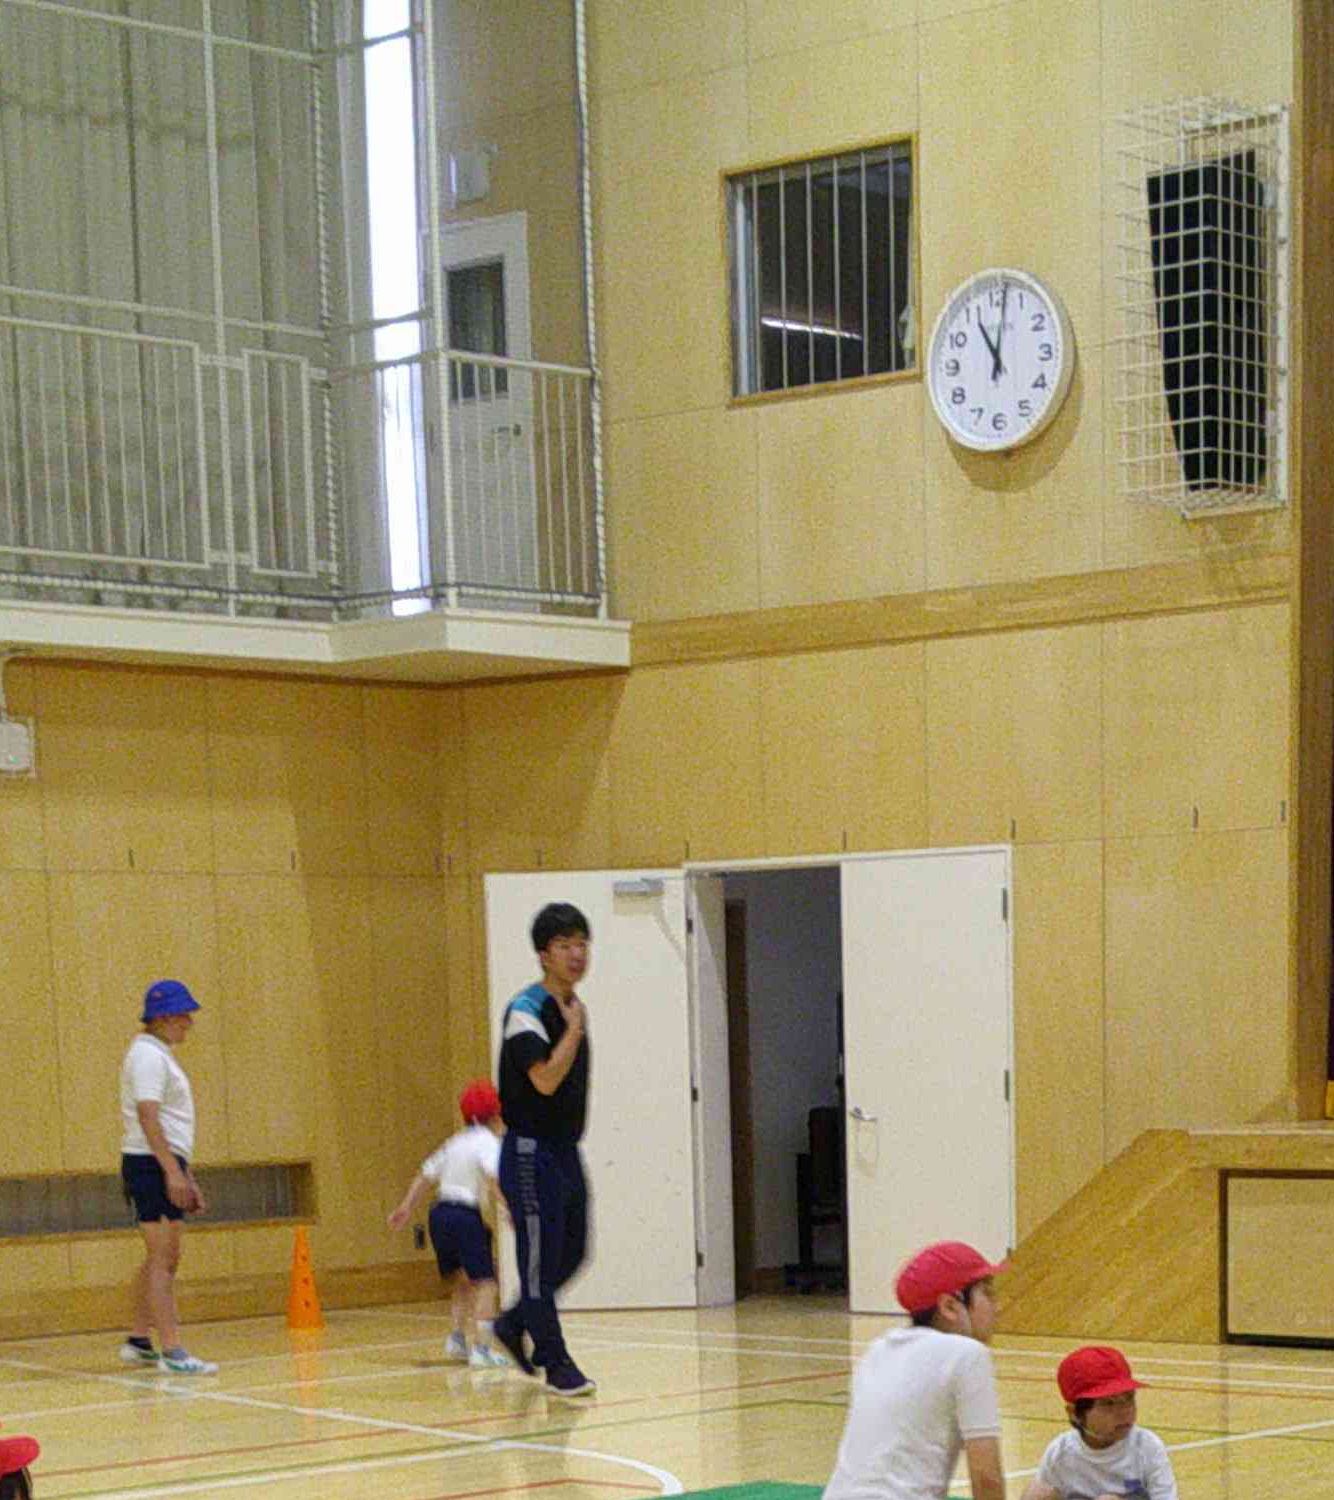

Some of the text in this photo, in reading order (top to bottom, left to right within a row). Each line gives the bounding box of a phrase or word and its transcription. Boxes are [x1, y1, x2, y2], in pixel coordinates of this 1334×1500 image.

[1018, 291, 1024, 311] 1
[1031, 313, 1046, 332] 2
[949, 331, 968, 350] 10
[1038, 344, 1053, 361] 3
[945, 359, 960, 377] 9
[1031, 372, 1047, 390] 4
[951, 387, 966, 405] 8
[970, 407, 984, 426] 7
[1018, 400, 1032, 417] 5
[992, 413, 1007, 431] 6
